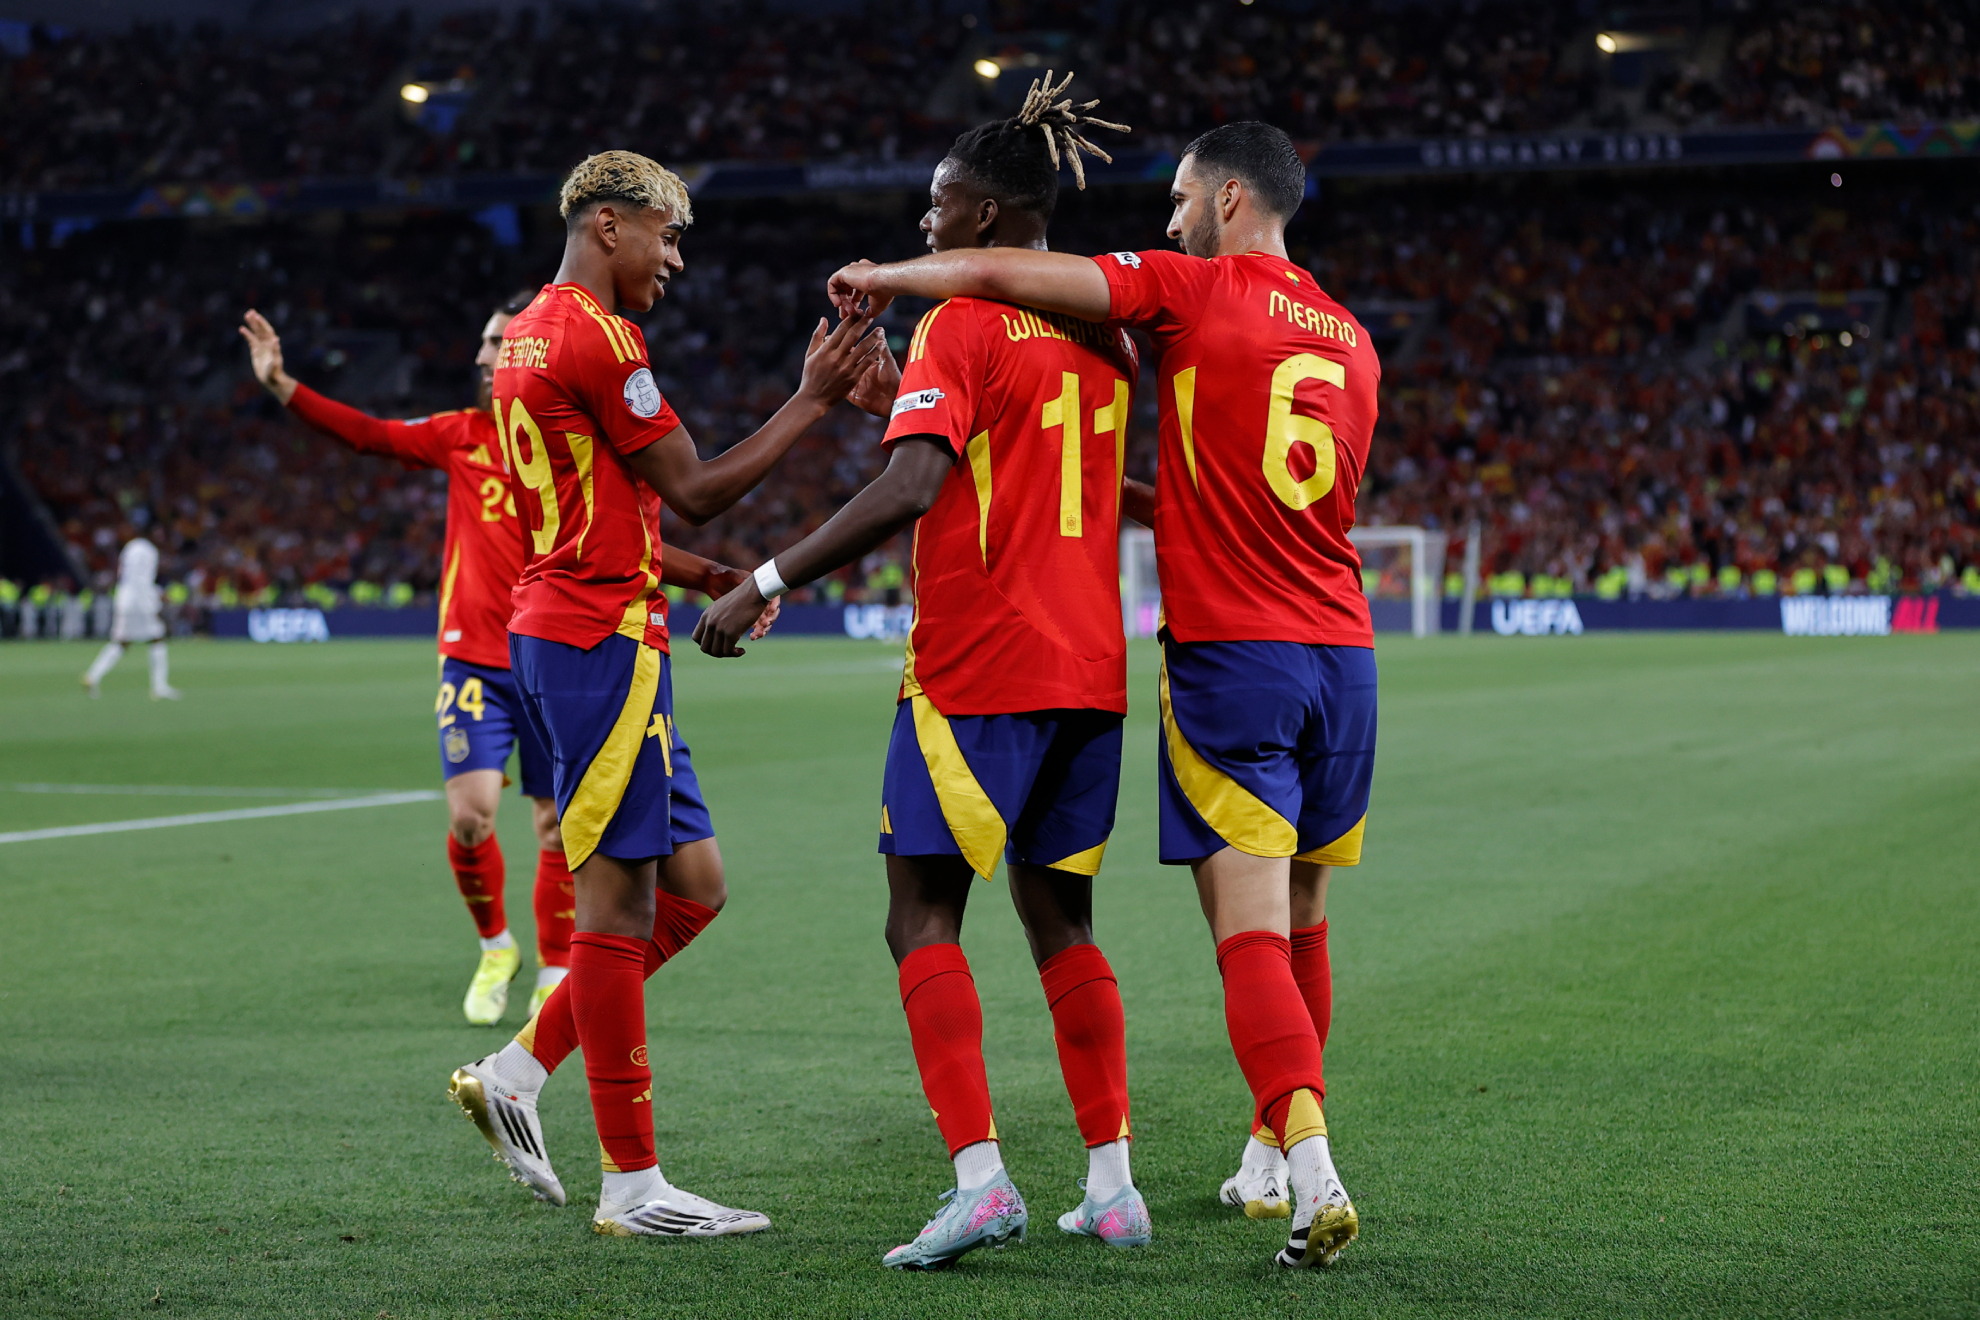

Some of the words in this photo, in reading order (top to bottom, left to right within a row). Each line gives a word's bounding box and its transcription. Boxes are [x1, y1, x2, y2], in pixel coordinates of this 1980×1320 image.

[1419, 139, 1583, 168] GERMANY
[1000, 307, 1116, 347] WILLIAMS
[1269, 290, 1358, 348] MERINO
[919, 393, 935, 404] 10
[1262, 352, 1346, 511] 6
[1041, 370, 1129, 538] 11
[493, 396, 561, 556] 19
[247, 607, 331, 644] UEFA
[1491, 598, 1584, 636] UEFA
[1780, 594, 1892, 637] WELCOME
[1892, 595, 1939, 635] ALL
[435, 677, 485, 729] 24
